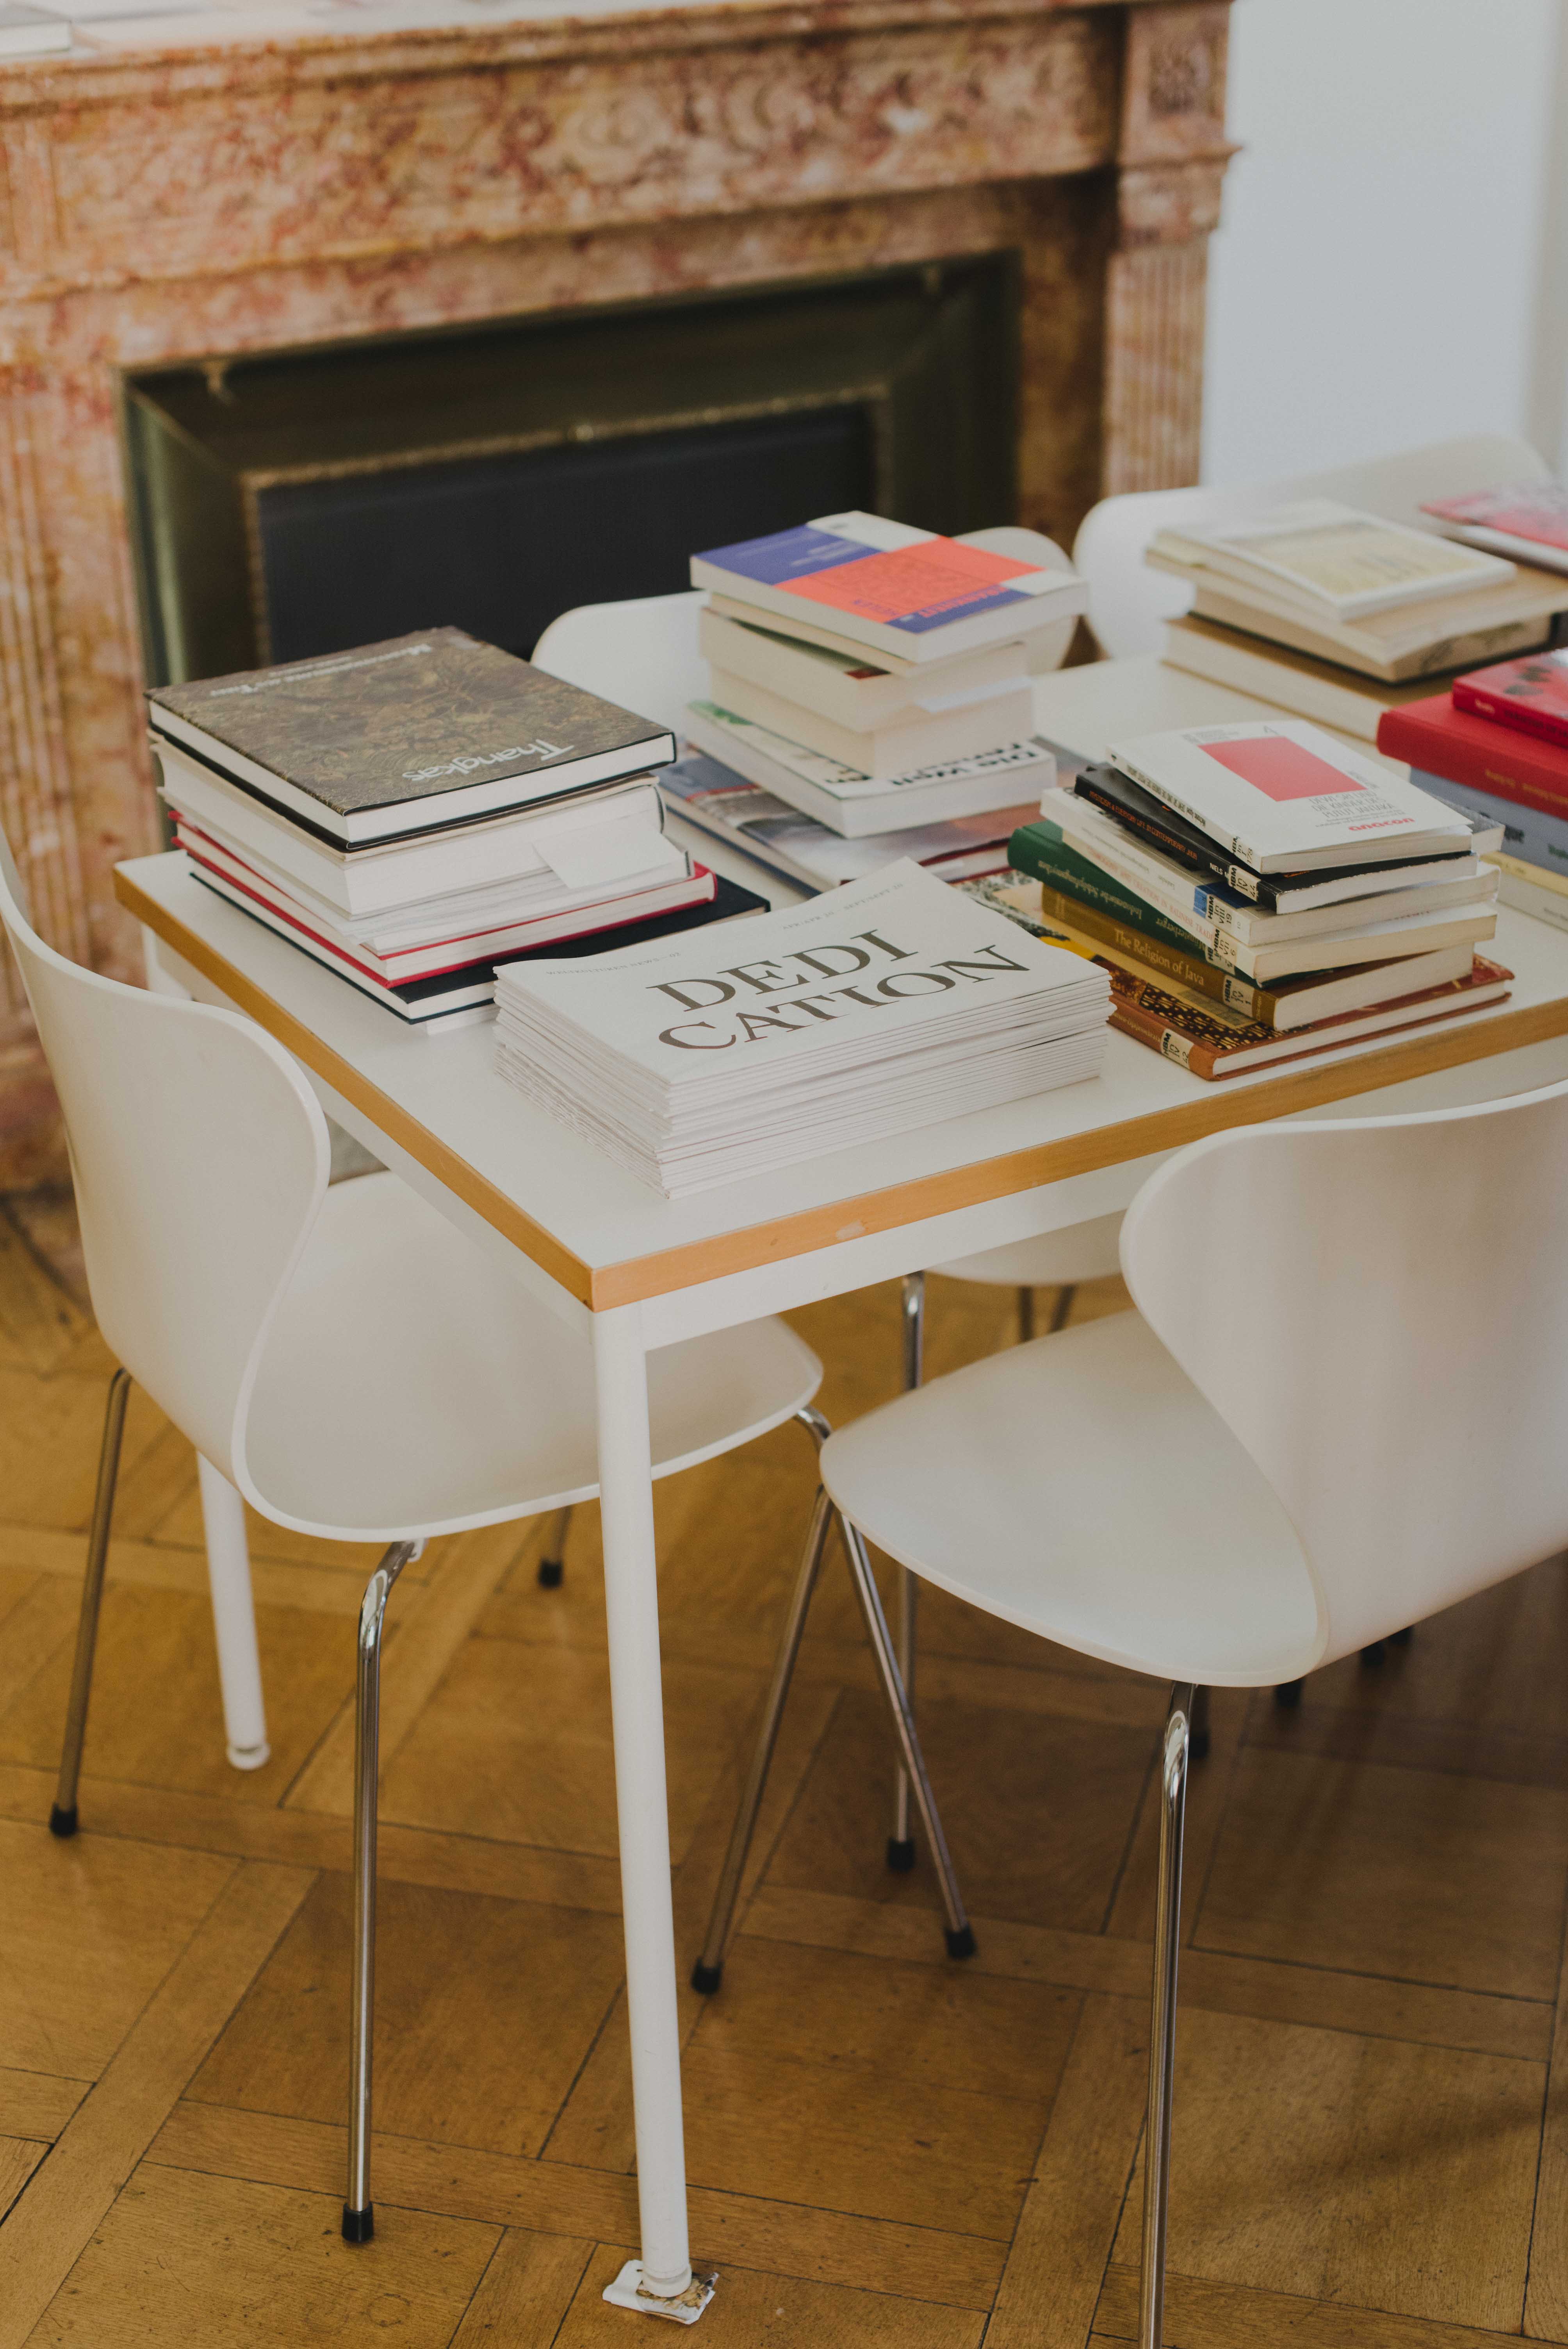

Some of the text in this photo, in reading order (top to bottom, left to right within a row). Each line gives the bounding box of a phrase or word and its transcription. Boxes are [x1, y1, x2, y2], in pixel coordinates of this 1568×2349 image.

[401, 739, 574, 782] Thangkas
[1348, 818, 1415, 831] anacon
[1210, 862, 1223, 875] NIELS
[843, 889, 890, 910] SEPT/SEPT
[1226, 913, 1232, 924] 19
[546, 964, 628, 975] WELTKULTUREN
[630, 957, 660, 967] NEWS
[1115, 927, 1205, 986] The Religion of Java
[646, 929, 921, 1012] DEDI
[658, 945, 1031, 1050] CATION
[1163, 1032, 1172, 1055] HBM
